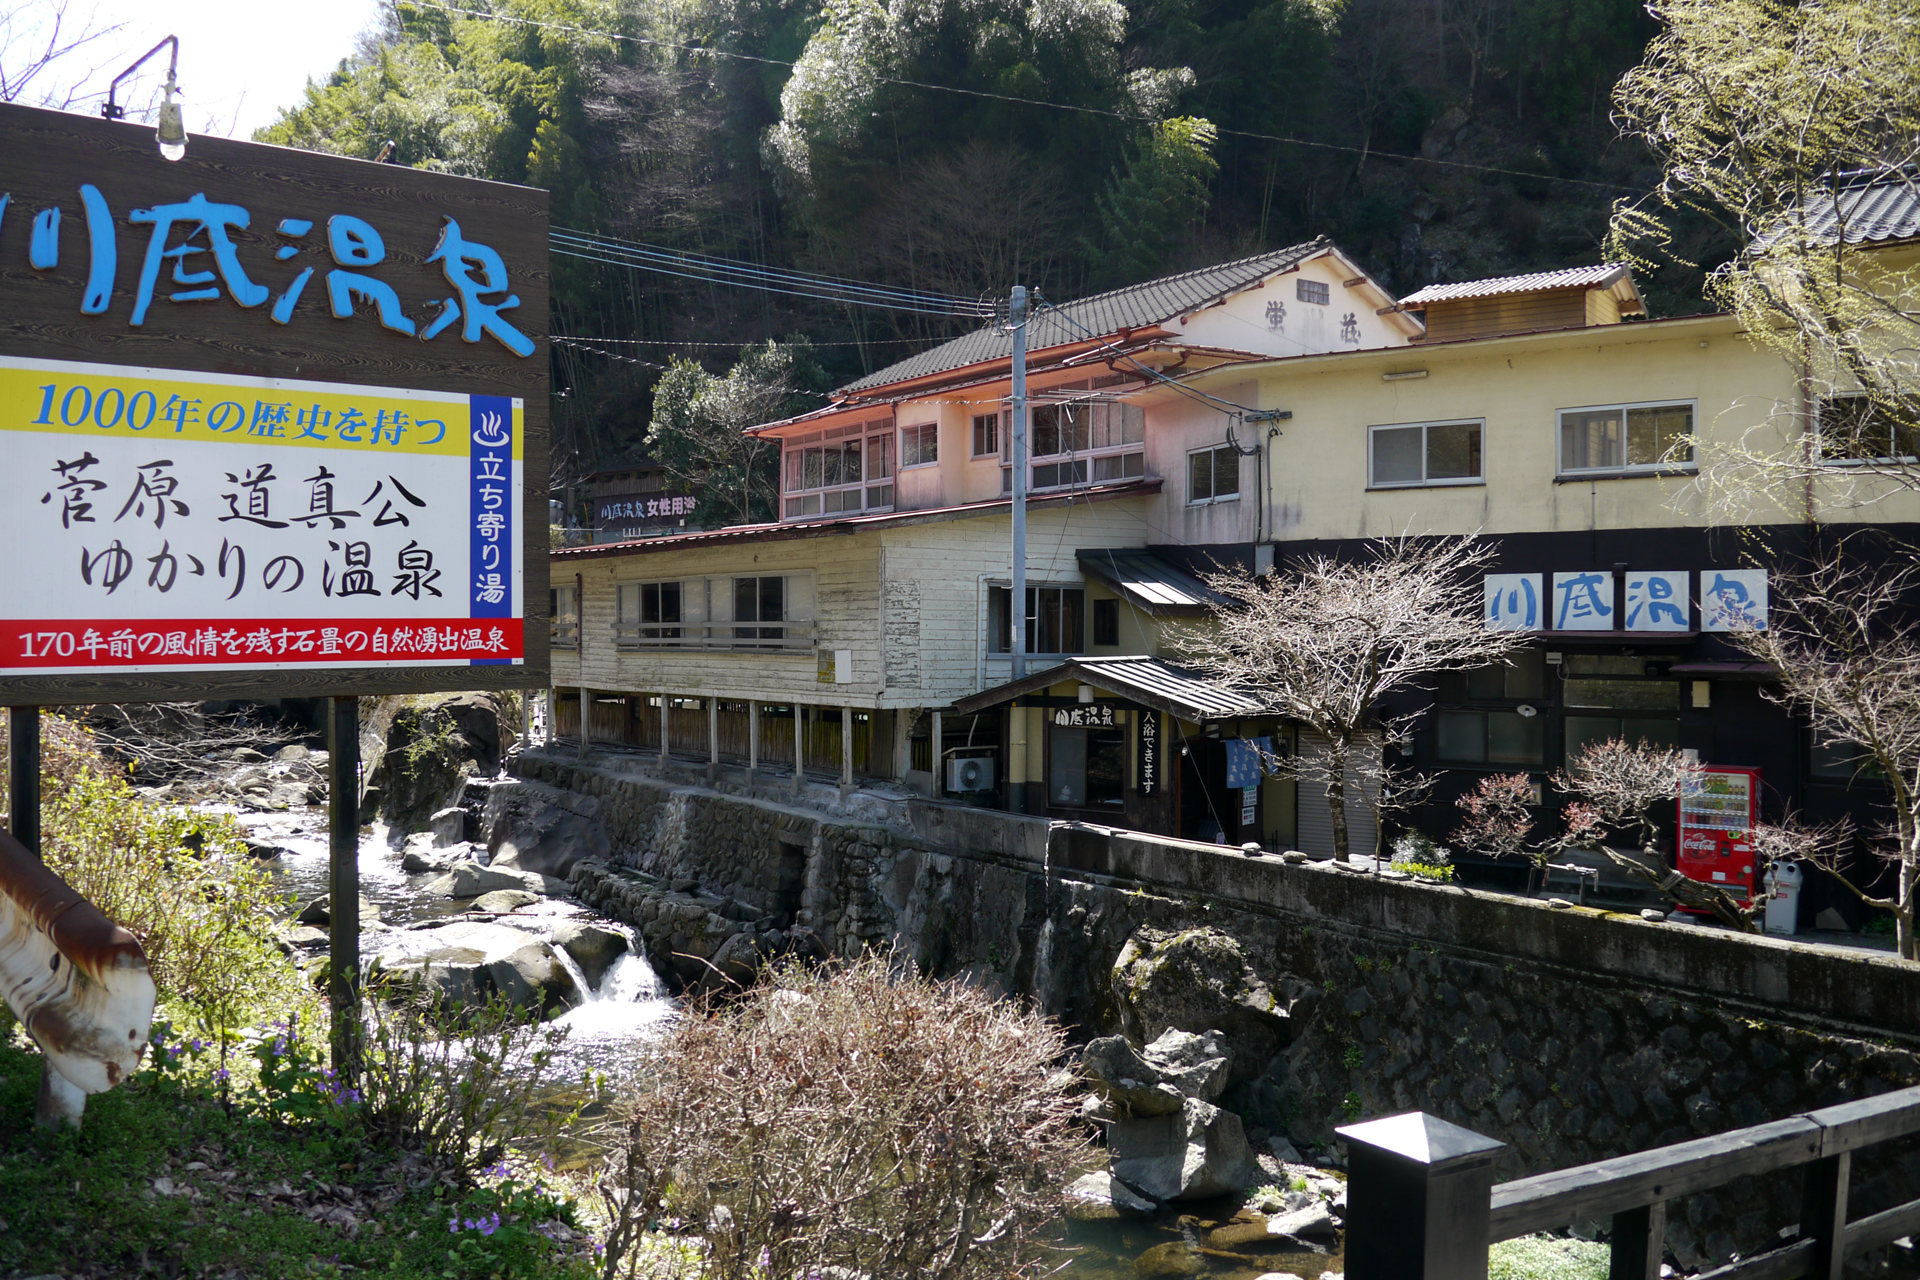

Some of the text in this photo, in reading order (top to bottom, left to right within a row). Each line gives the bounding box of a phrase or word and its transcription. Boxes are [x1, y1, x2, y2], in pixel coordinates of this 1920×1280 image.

[0, 184, 536, 358] 川底温泉
[30, 383, 447, 446] 1000年の歴史を持つ
[217, 462, 427, 531] 道真公
[475, 452, 507, 605] 立ち寄り湯
[81, 536, 443, 602] ゆかりの温泉
[18, 625, 510, 661] 170年前の風情を残す石畳の自然湧出温泉
[1055, 705, 1113, 726] 川底温泉
[1143, 711, 1156, 794] 入浴できます
